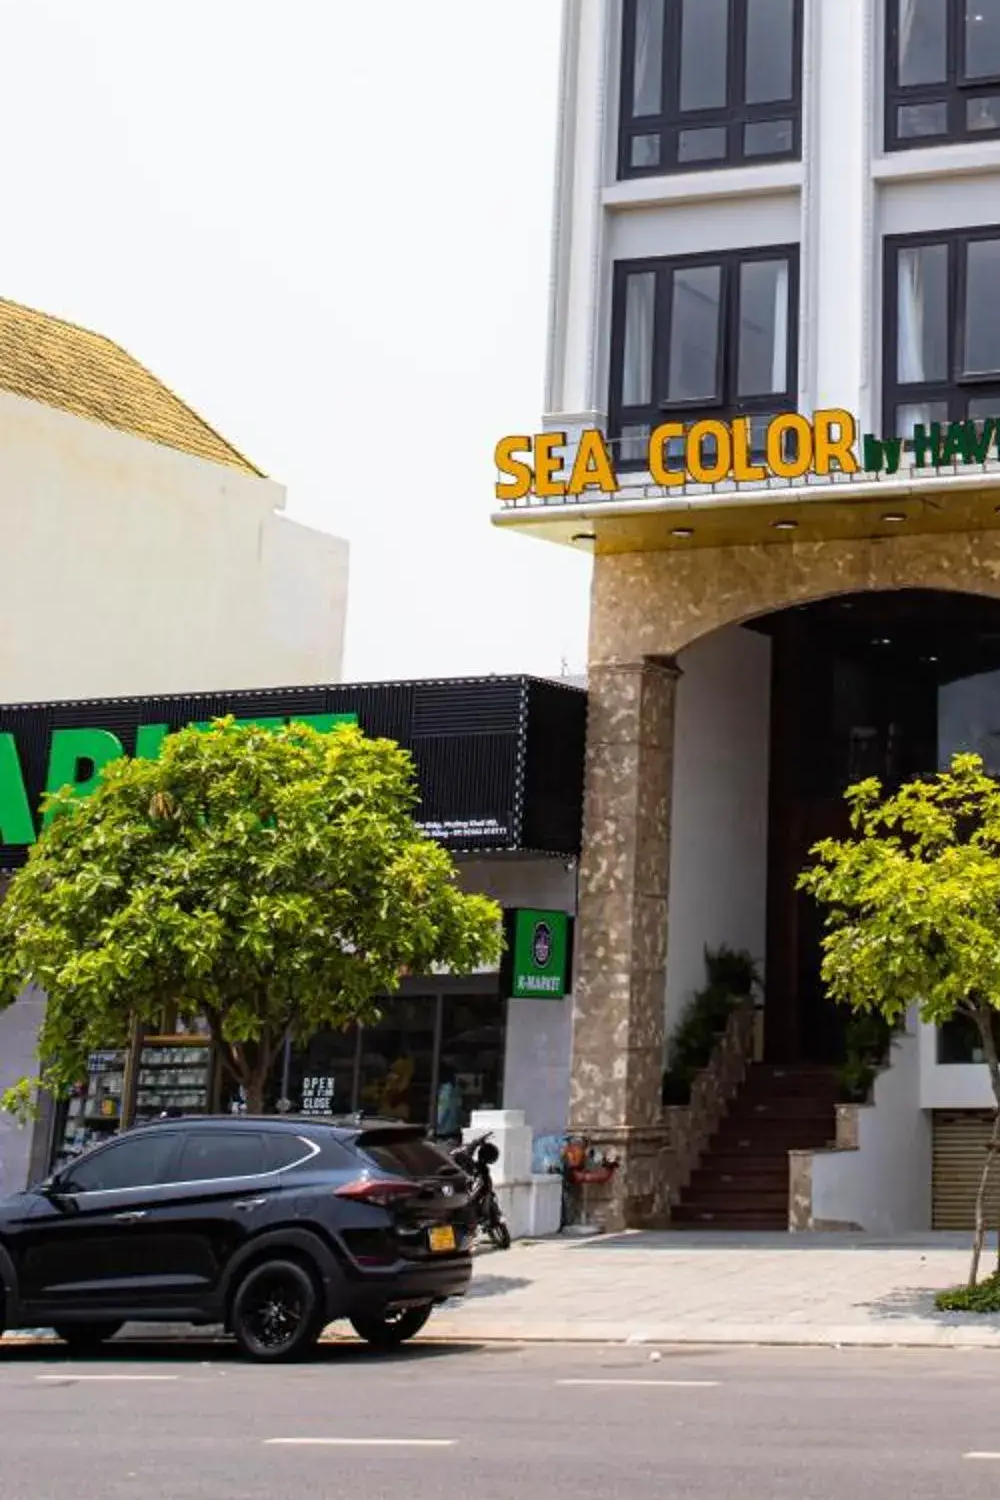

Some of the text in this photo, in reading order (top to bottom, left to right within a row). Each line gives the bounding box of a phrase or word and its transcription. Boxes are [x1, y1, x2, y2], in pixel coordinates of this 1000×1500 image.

[494, 428, 620, 499] SEA
[648, 408, 860, 487] COLOR
[863, 433, 901, 474] by
[303, 1077, 335, 1089] OPEN
[303, 1097, 331, 1109] CLOSE
